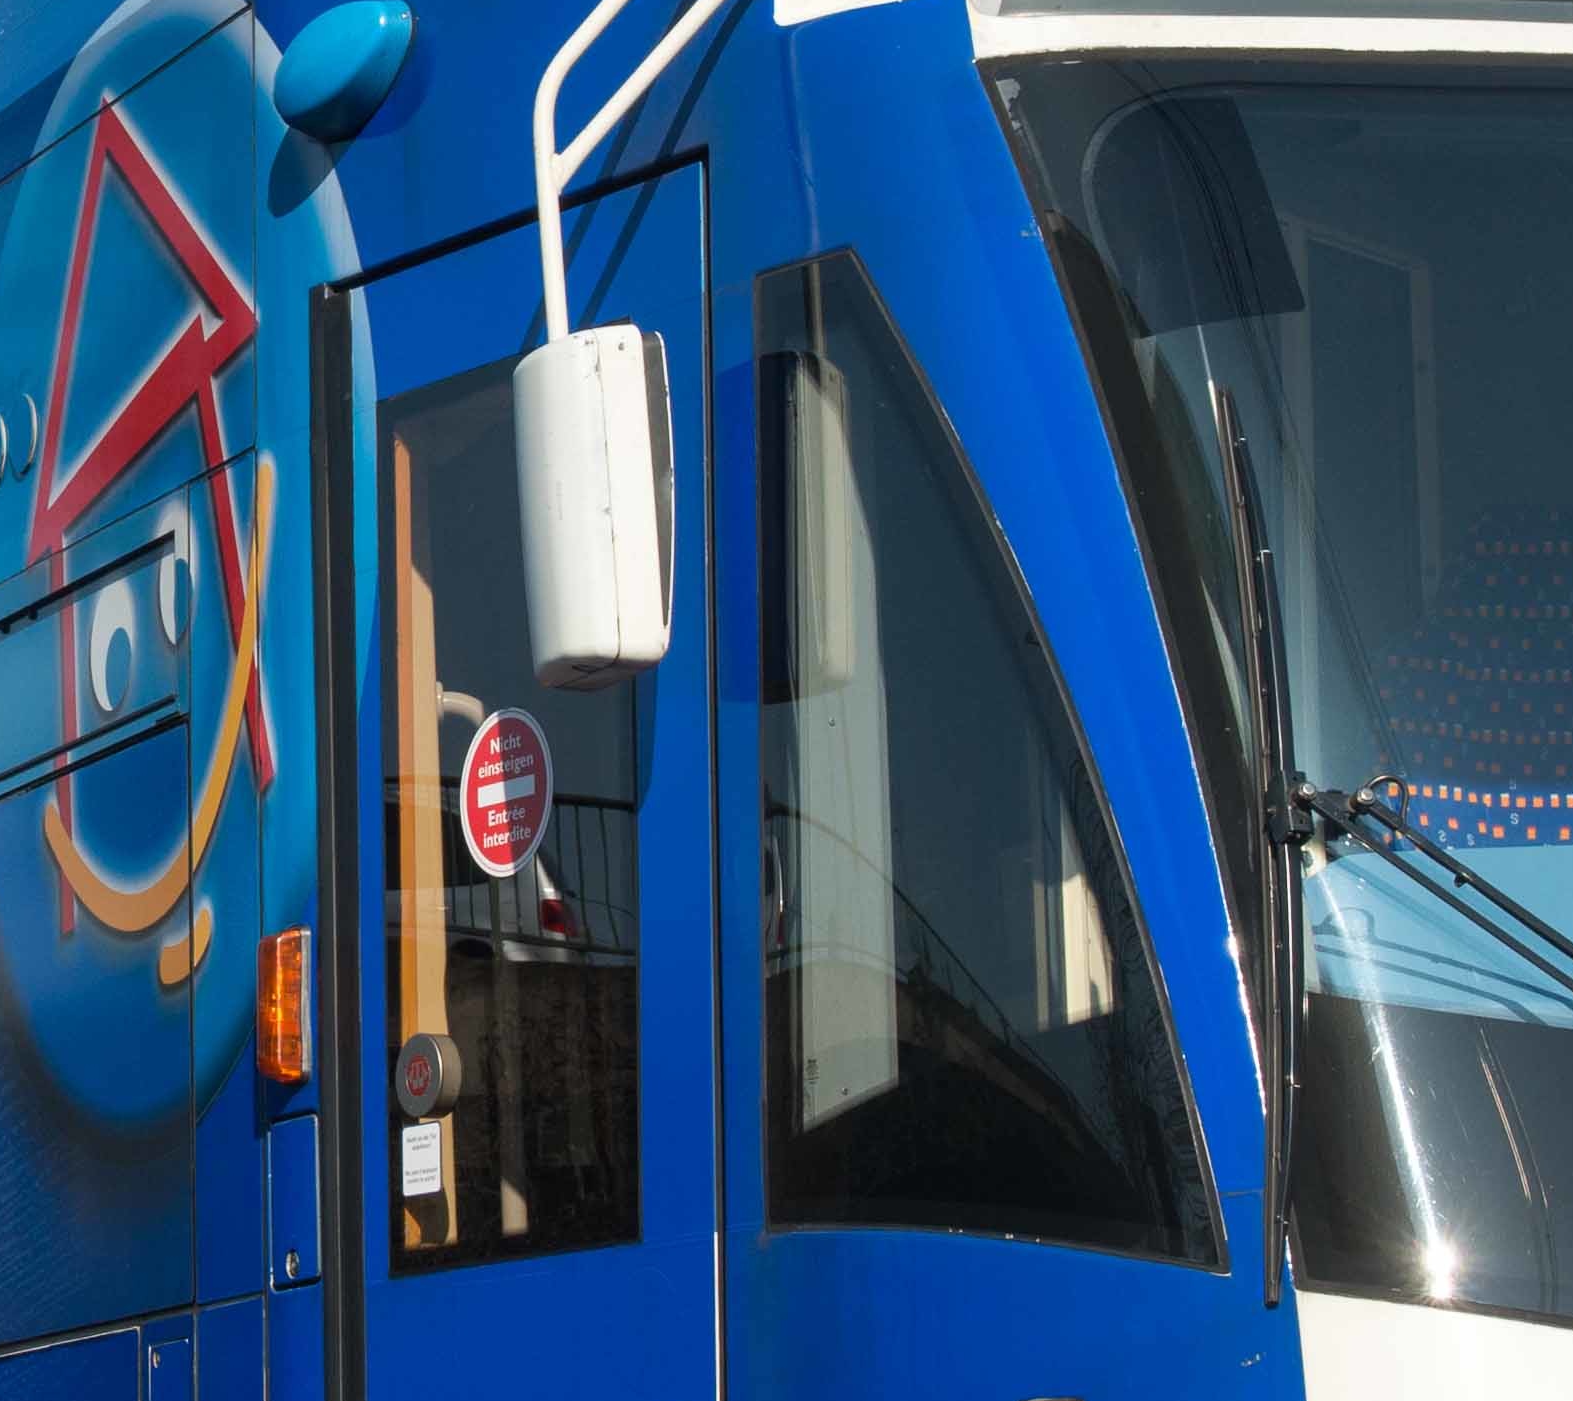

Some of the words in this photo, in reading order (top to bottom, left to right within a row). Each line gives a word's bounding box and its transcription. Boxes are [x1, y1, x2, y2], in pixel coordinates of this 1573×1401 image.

[490, 734, 522, 755] Nicht
[478, 754, 534, 779] einsteigen
[487, 806, 526, 827] Entrée
[483, 825, 532, 849] interdite
